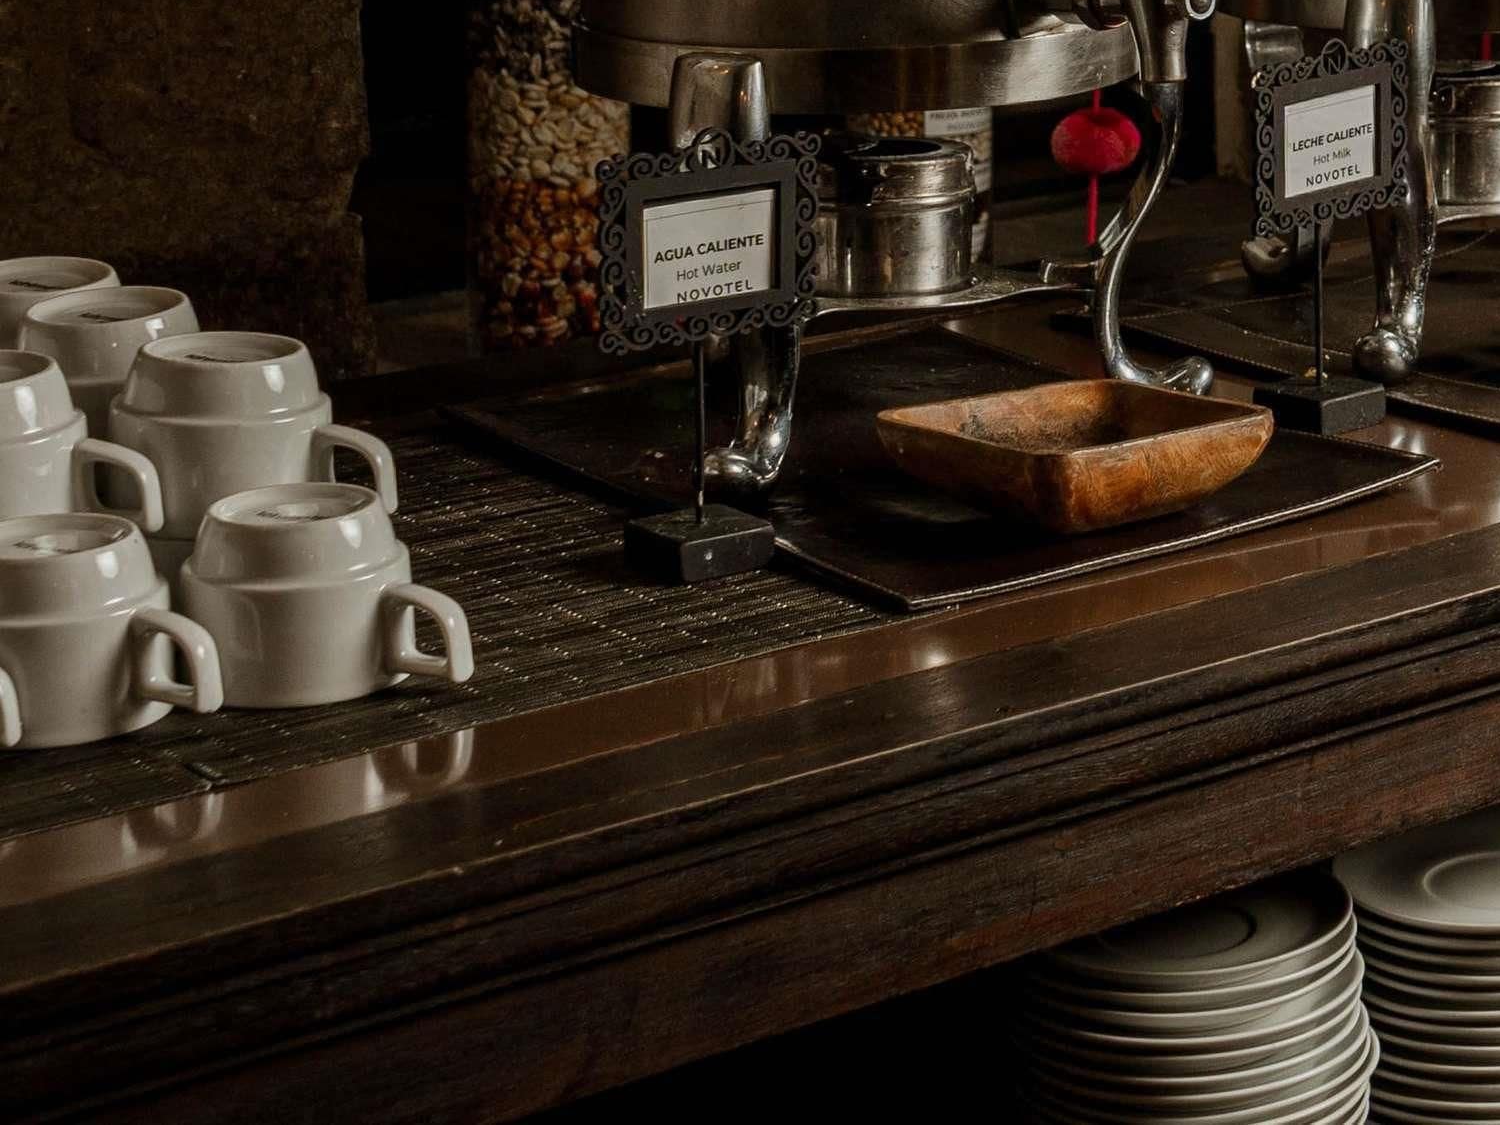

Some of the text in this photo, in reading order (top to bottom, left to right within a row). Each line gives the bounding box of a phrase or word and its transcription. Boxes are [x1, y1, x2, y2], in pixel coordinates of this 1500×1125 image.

[1292, 123, 1373, 152] LECHE CALIENTE
[1313, 146, 1352, 166] Hot Milk
[1305, 164, 1361, 187] NOVOTEL
[654, 233, 765, 264] AGUA CALIENTE
[676, 259, 742, 281] Hot Water
[677, 279, 754, 304] NOVOTEL
